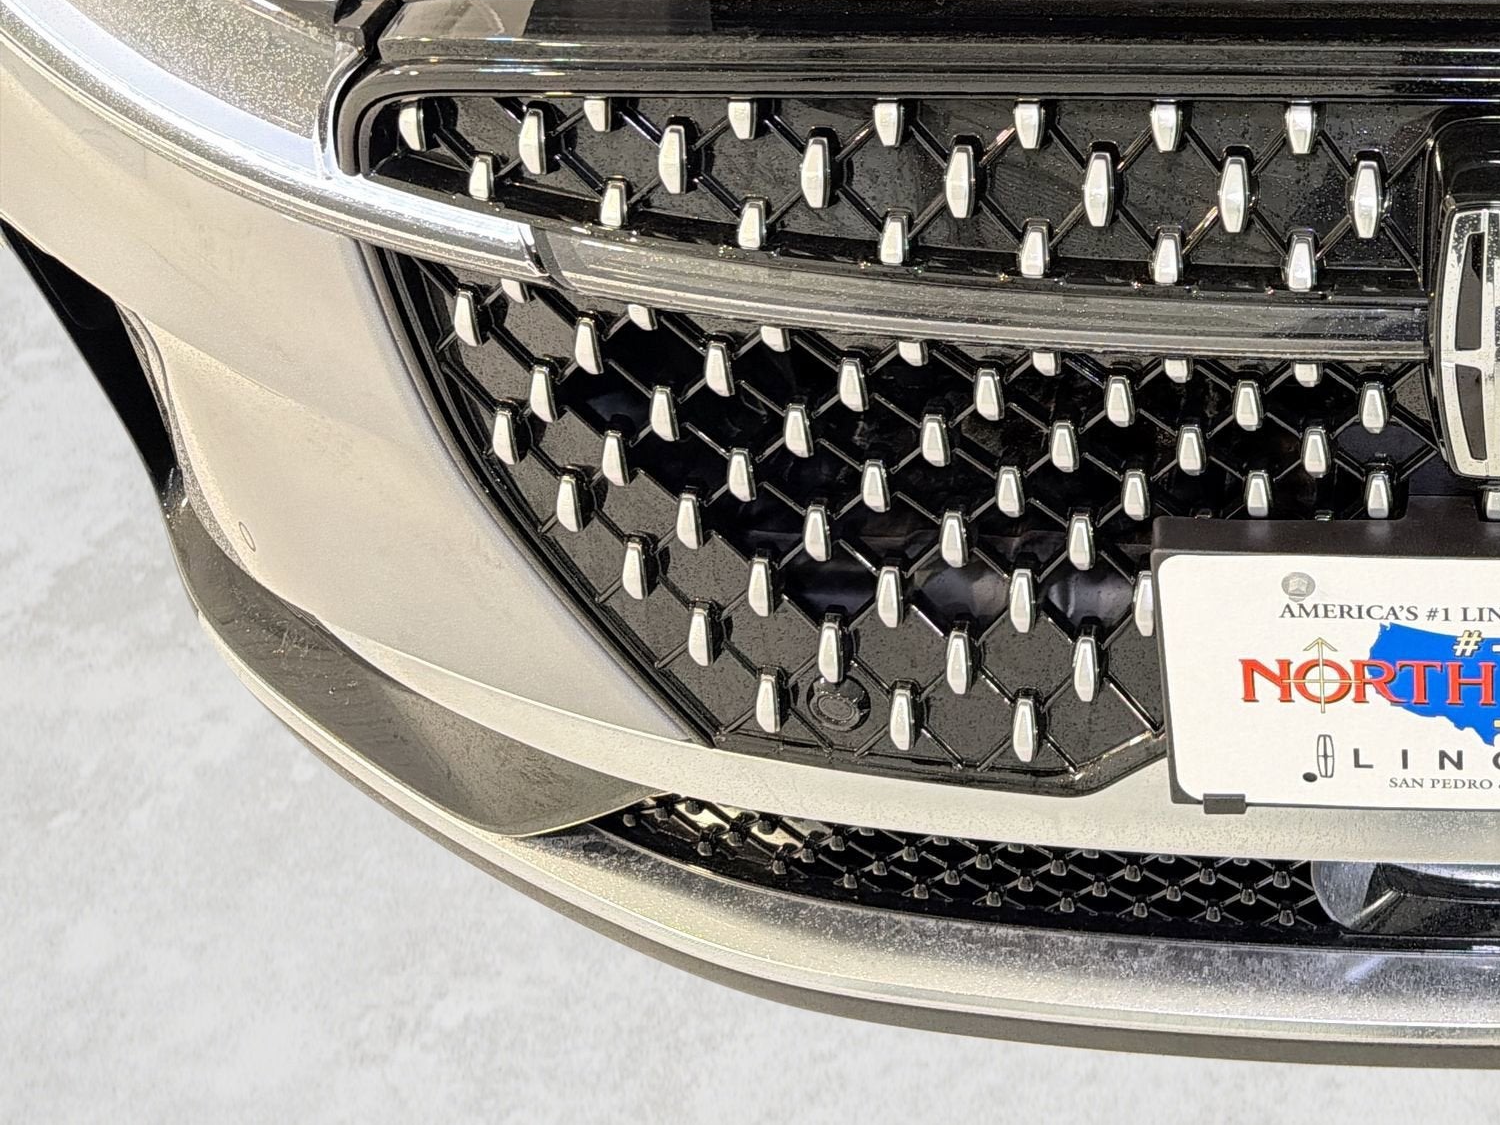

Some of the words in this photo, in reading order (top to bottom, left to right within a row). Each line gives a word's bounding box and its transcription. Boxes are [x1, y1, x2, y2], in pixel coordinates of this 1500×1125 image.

[1279, 602, 1419, 621] AMERICA'S
[1425, 607, 1452, 622] #1
[1239, 658, 1498, 707] NORTH
[1388, 776, 1425, 789] SAN
[1429, 777, 1493, 790] PEDRO
